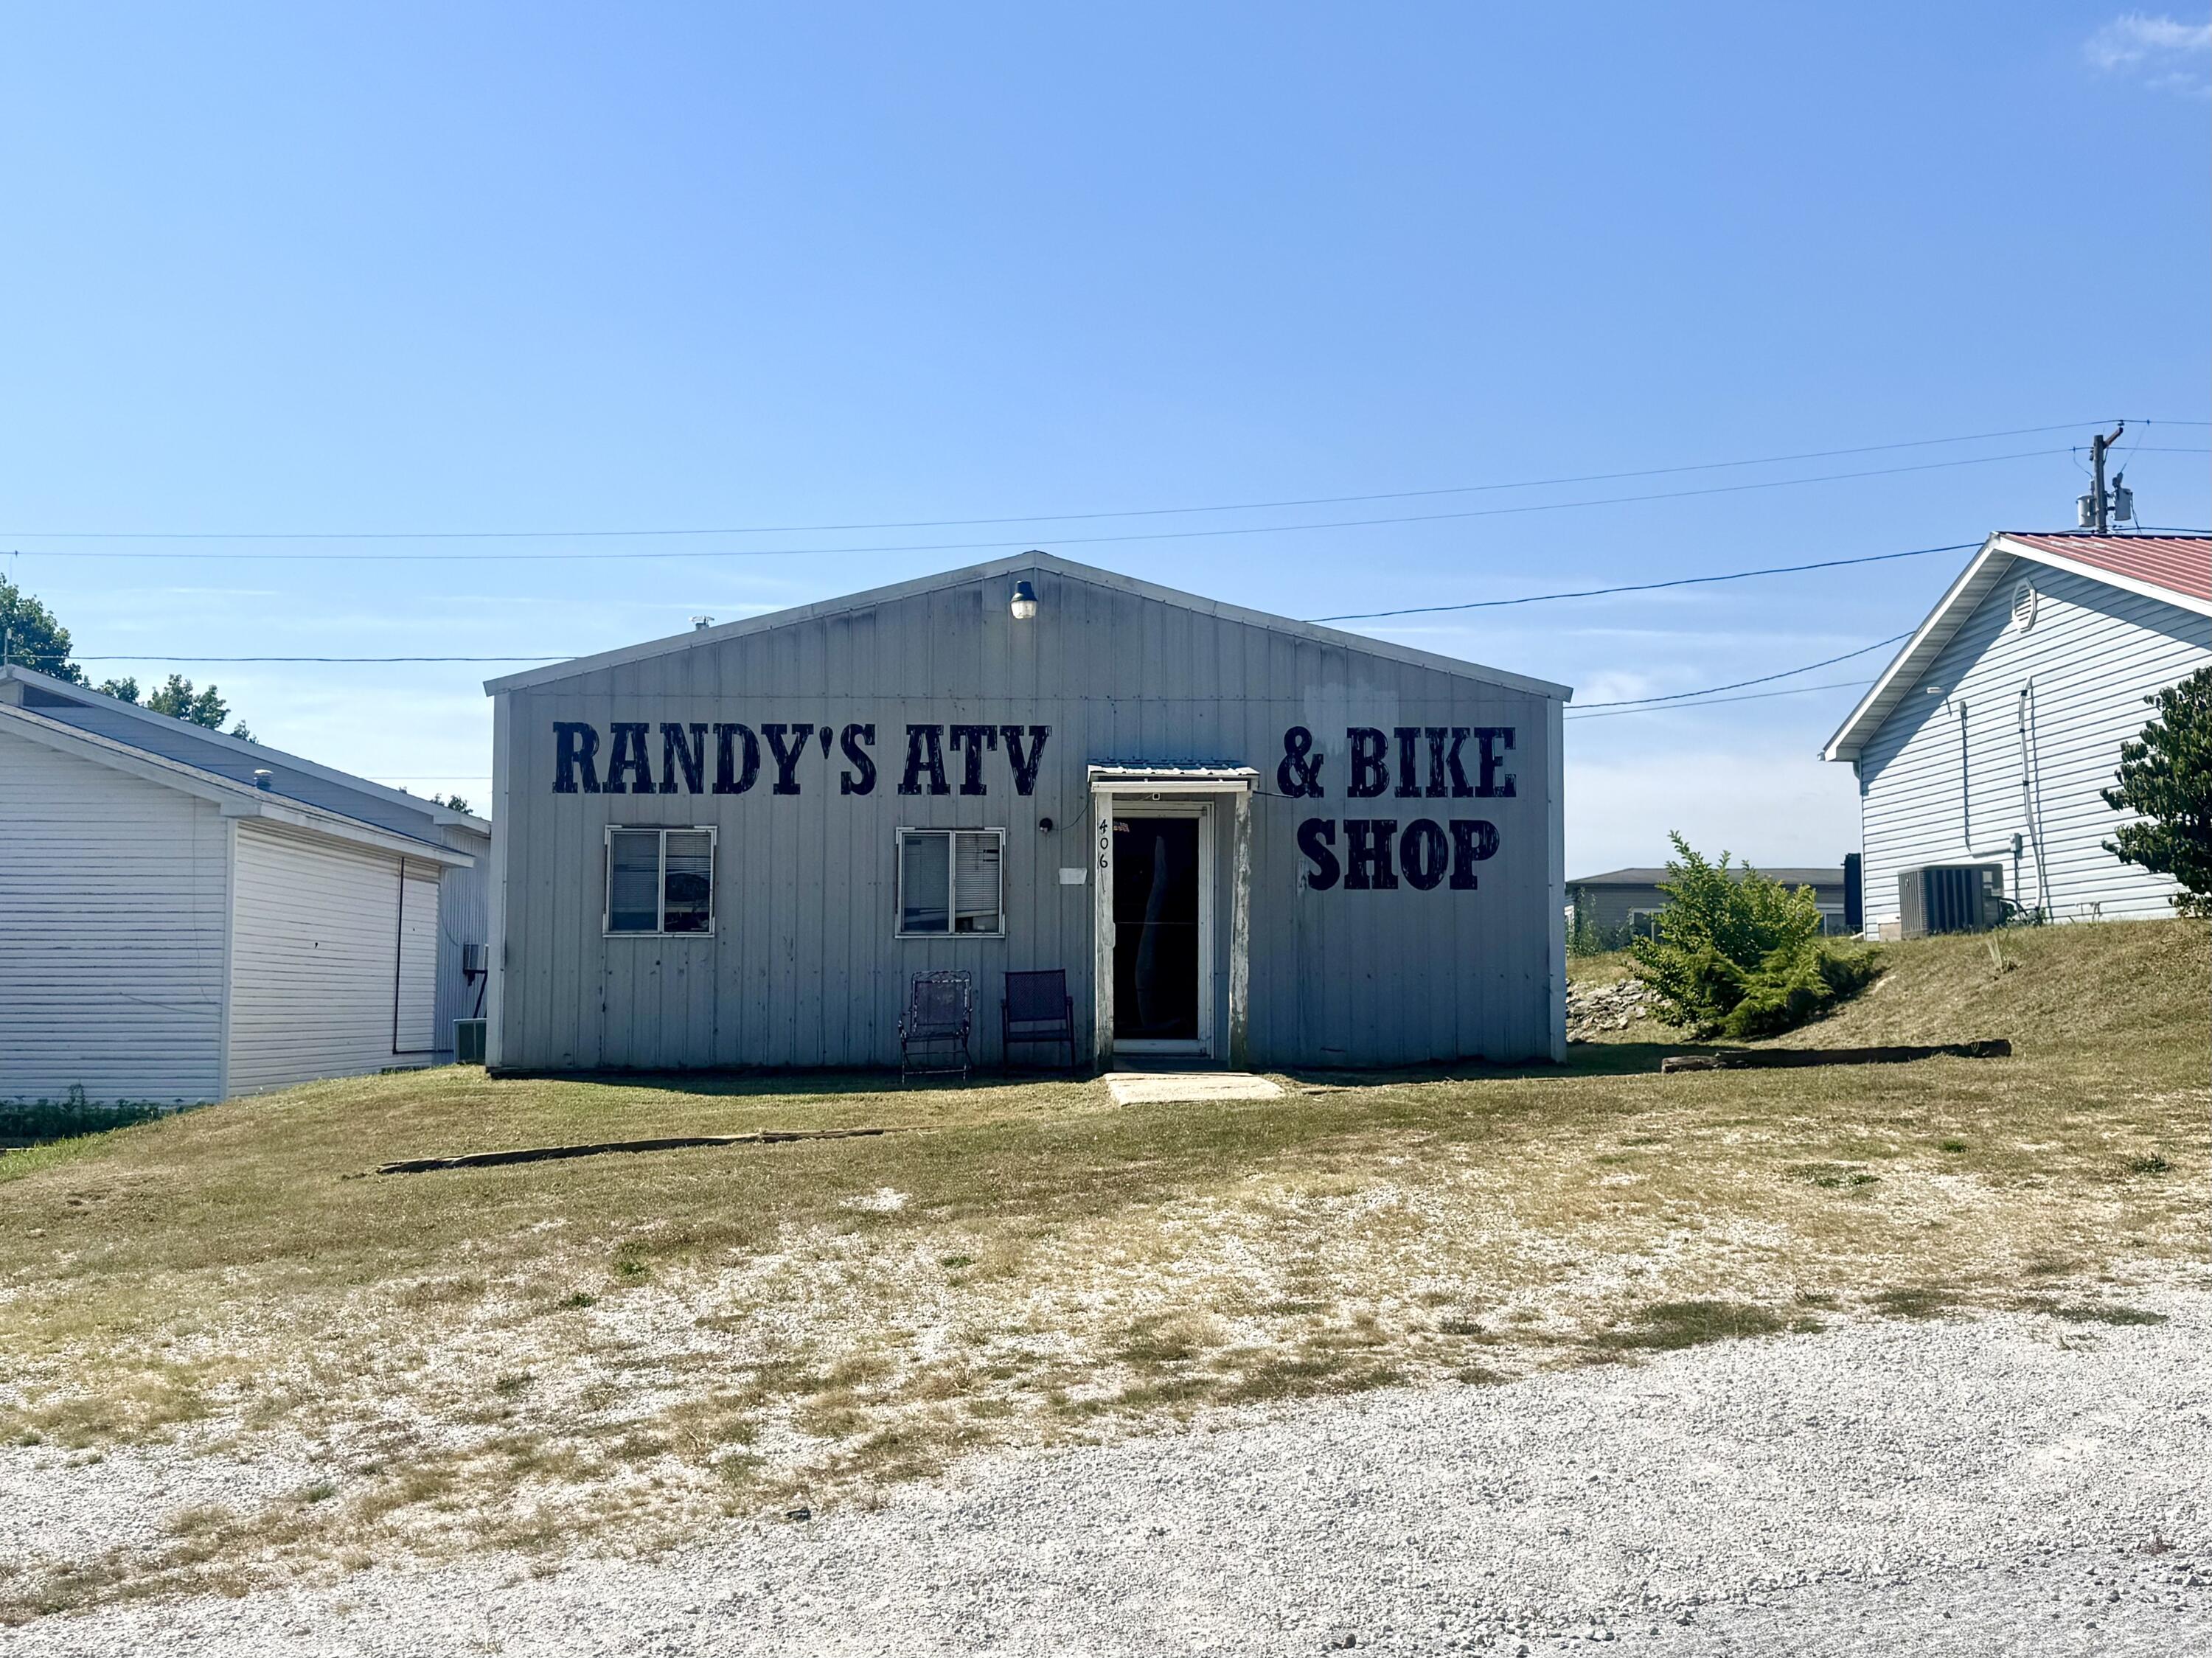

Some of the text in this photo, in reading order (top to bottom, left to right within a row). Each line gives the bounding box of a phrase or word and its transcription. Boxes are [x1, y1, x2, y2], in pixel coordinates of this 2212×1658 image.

[552, 722, 1517, 798] RANDY'S ATV & BIKE
[1099, 818, 1109, 868] 406
[1297, 818, 1500, 891] SHOP
